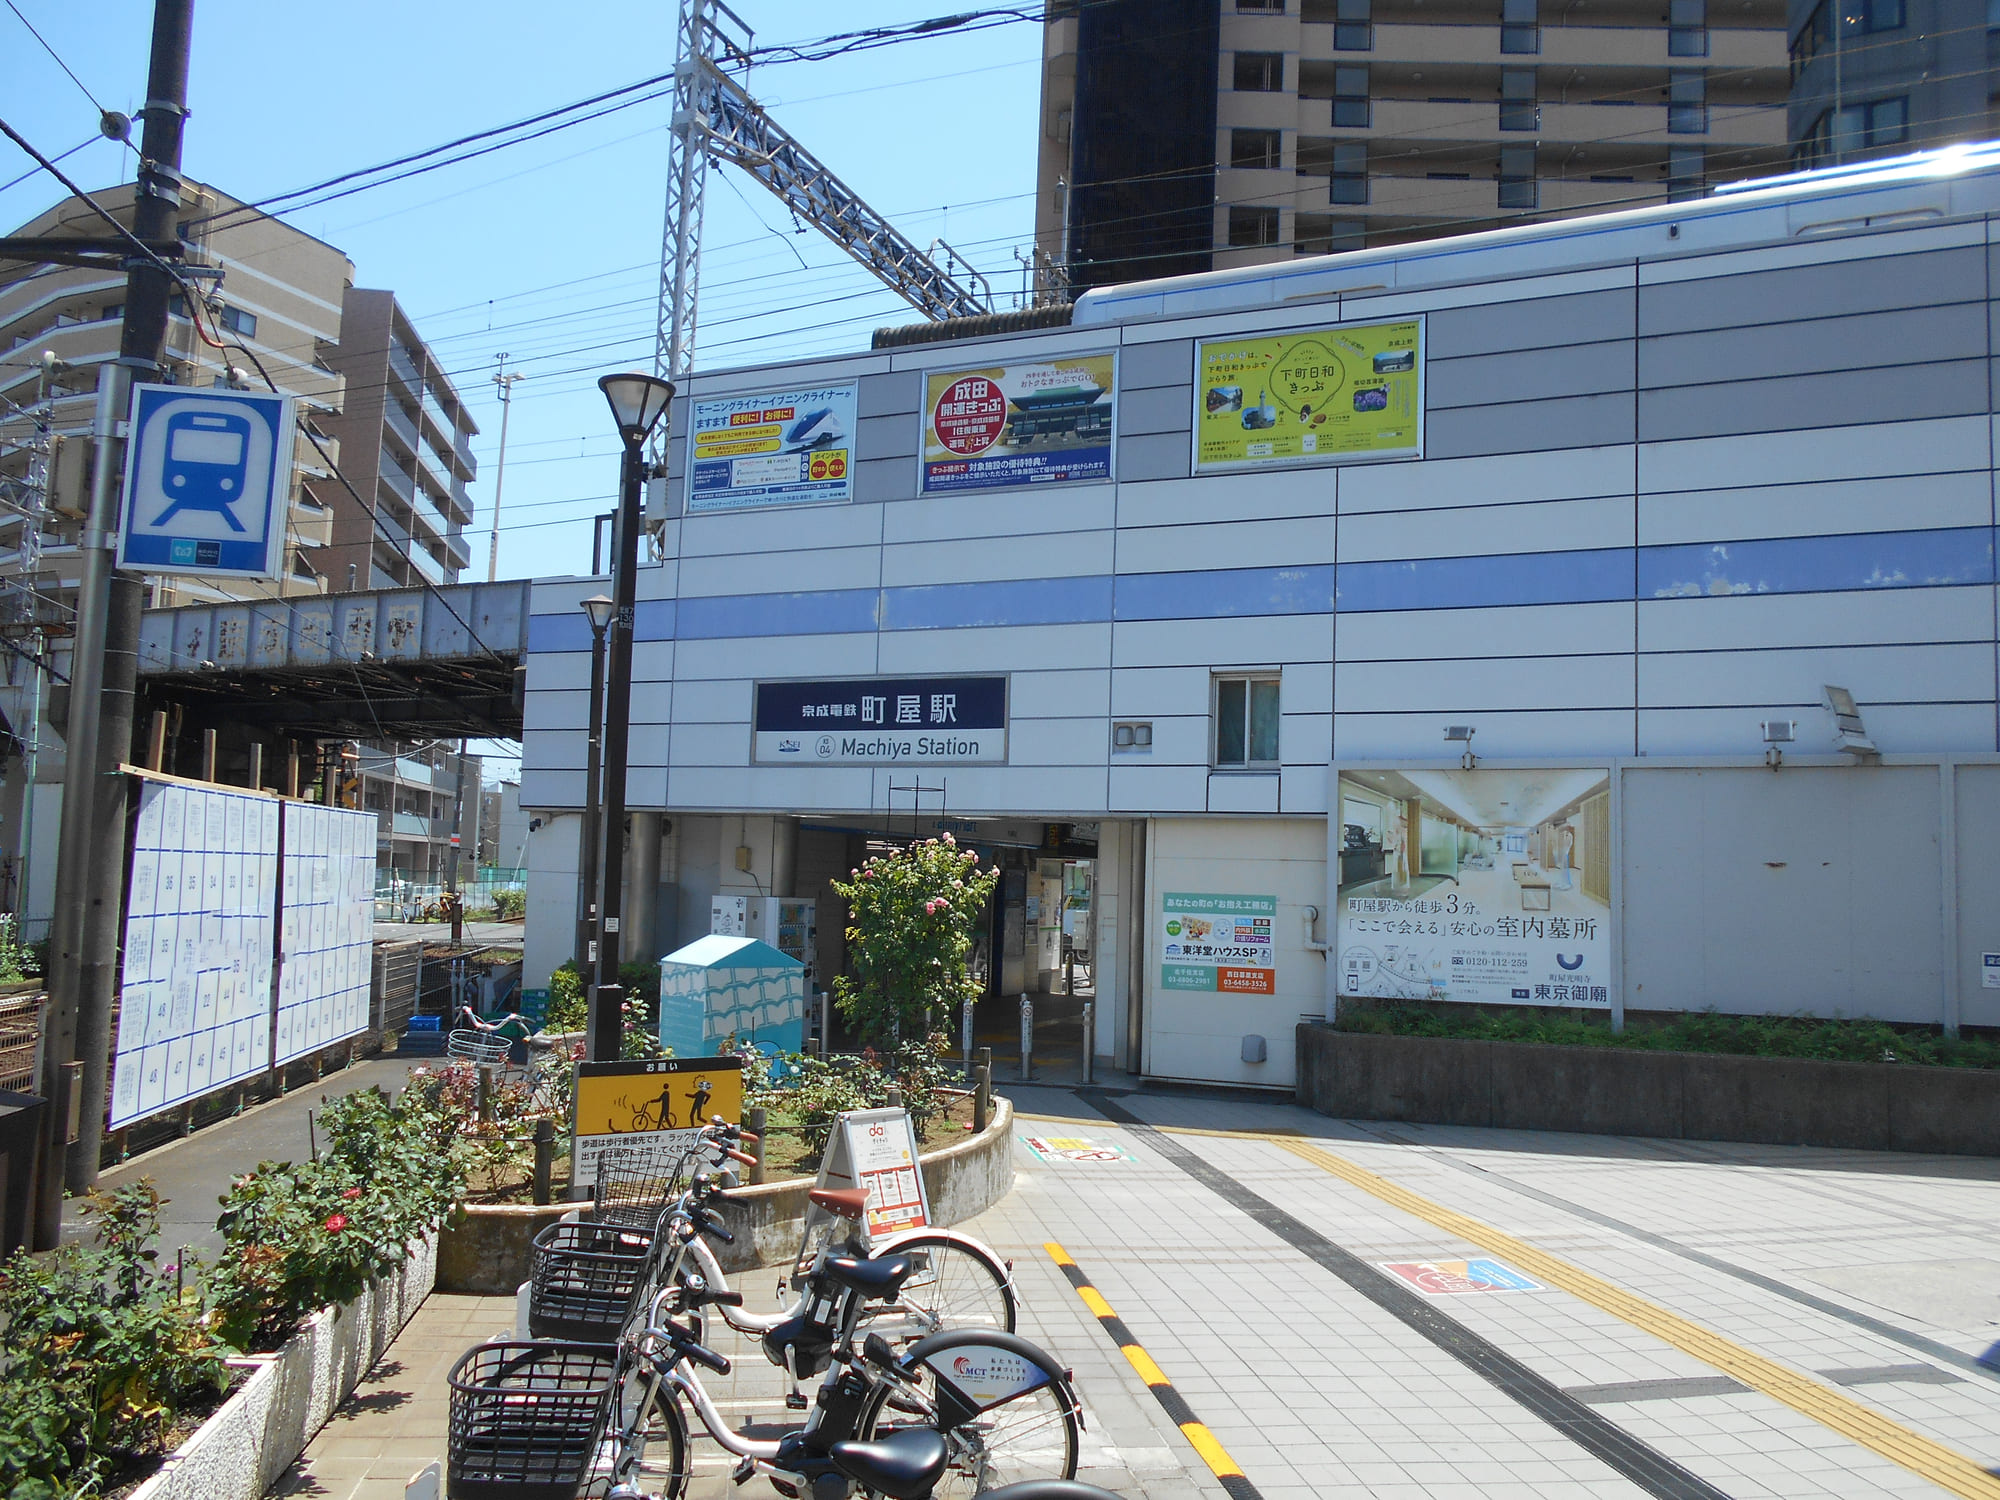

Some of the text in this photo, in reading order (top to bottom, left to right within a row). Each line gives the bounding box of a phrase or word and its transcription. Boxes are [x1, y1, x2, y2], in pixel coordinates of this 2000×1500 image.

[1207, 361, 1268, 374] 下町日和きっぷで
[1280, 365, 1335, 382] 下町日和
[954, 380, 988, 401] 成田
[1289, 382, 1325, 395] きっぷ
[940, 397, 1002, 417] 開運きっぷ
[696, 416, 728, 430] ますます
[802, 694, 958, 725] 京成電鉄 町屋駅
[819, 745, 832, 755] 04
[841, 737, 979, 760] Machiya Station
[1348, 893, 1482, 915] 町屋駅から徒歩3分。
[1182, 945, 1258, 957] 東洋堂ハウスSP
[1466, 957, 1528, 968] 0120-112-259
[1534, 984, 1608, 1003] 東京御廟
[646, 1062, 678, 1073] お願い
[965, 1367, 987, 1376] MCT
